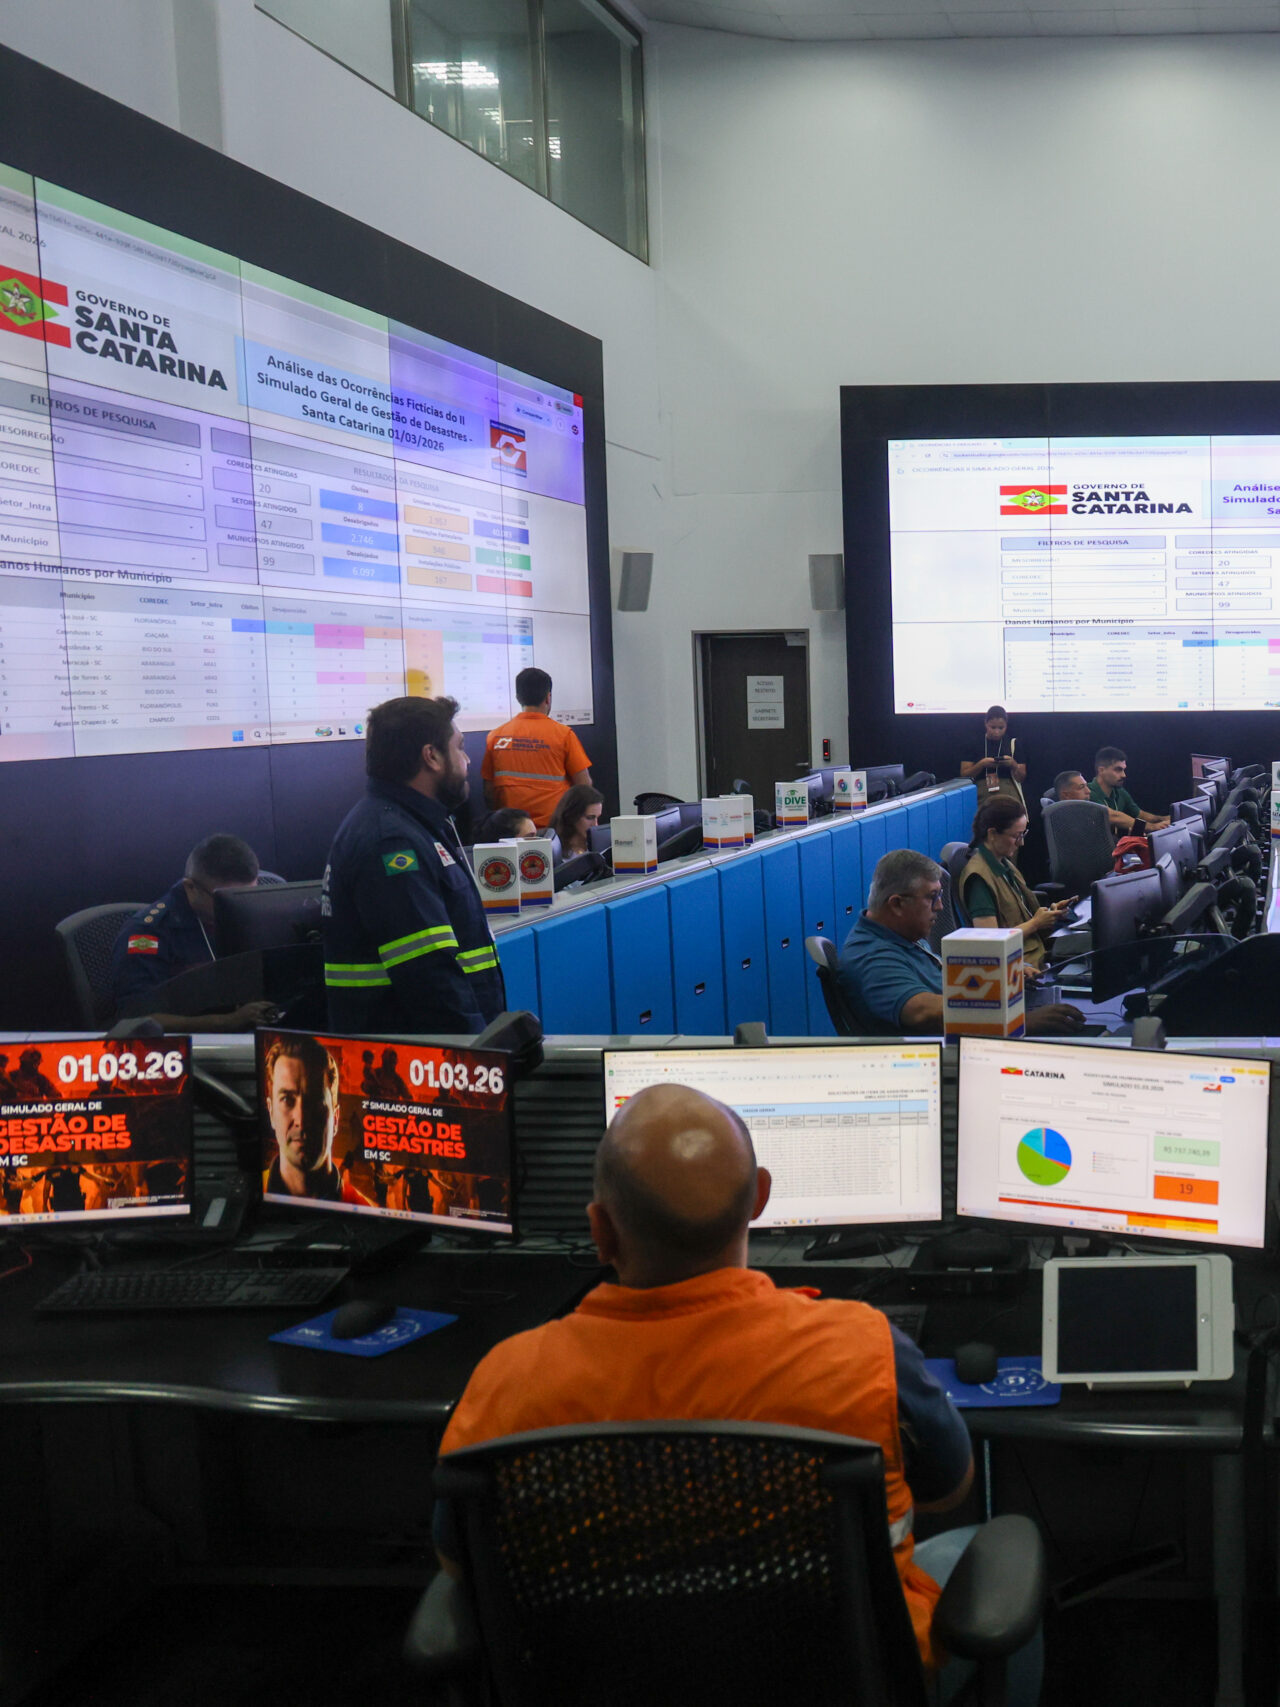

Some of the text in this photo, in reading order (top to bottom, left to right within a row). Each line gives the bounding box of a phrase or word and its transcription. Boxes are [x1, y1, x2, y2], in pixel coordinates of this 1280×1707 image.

[75, 289, 171, 328] GOVERNO DE
[75, 305, 178, 354] SANTA
[75, 330, 228, 391] CATARINA
[267, 355, 466, 426] Análise das Ocorrências Fictícias do II
[29, 393, 157, 431] FILTROS DE PESQUISA
[257, 372, 317, 399] Simulado
[320, 390, 351, 410] Geral
[354, 400, 369, 415] de
[371, 405, 408, 427] Gestão
[409, 415, 422, 429] de
[424, 420, 468, 443] Desastres
[301, 404, 445, 453] Santa Catarina 01/03/2026
[258, 483, 271, 495] 20
[1072, 491, 1151, 502] SANTA
[1071, 502, 1194, 515] CATARINA
[260, 519, 273, 530] 47
[351, 533, 374, 546] 2.746
[262, 556, 275, 567] 99
[351, 565, 376, 577] 6.097
[784, 796, 806, 805] DIVE
[948, 957, 1000, 966] DEFESA CIVIL
[58, 1051, 183, 1083] 01.03.26
[409, 1059, 504, 1095] 01.03.26
[1024, 1069, 1066, 1080] CATARINA
[1, 1101, 102, 1115] SIMULADO GERAL DE
[370, 1101, 408, 1114] SIMULADO
[408, 1105, 431, 1116] GERAL
[432, 1108, 443, 1117] DE
[93, 1114, 127, 1133] DE
[362, 1114, 463, 1142] GESTÃO DE
[363, 1132, 466, 1159] DESASTRES
[0, 1155, 28, 1166] M SC
[364, 1149, 391, 1162] EM SC
[1178, 1184, 1194, 1195] 19
